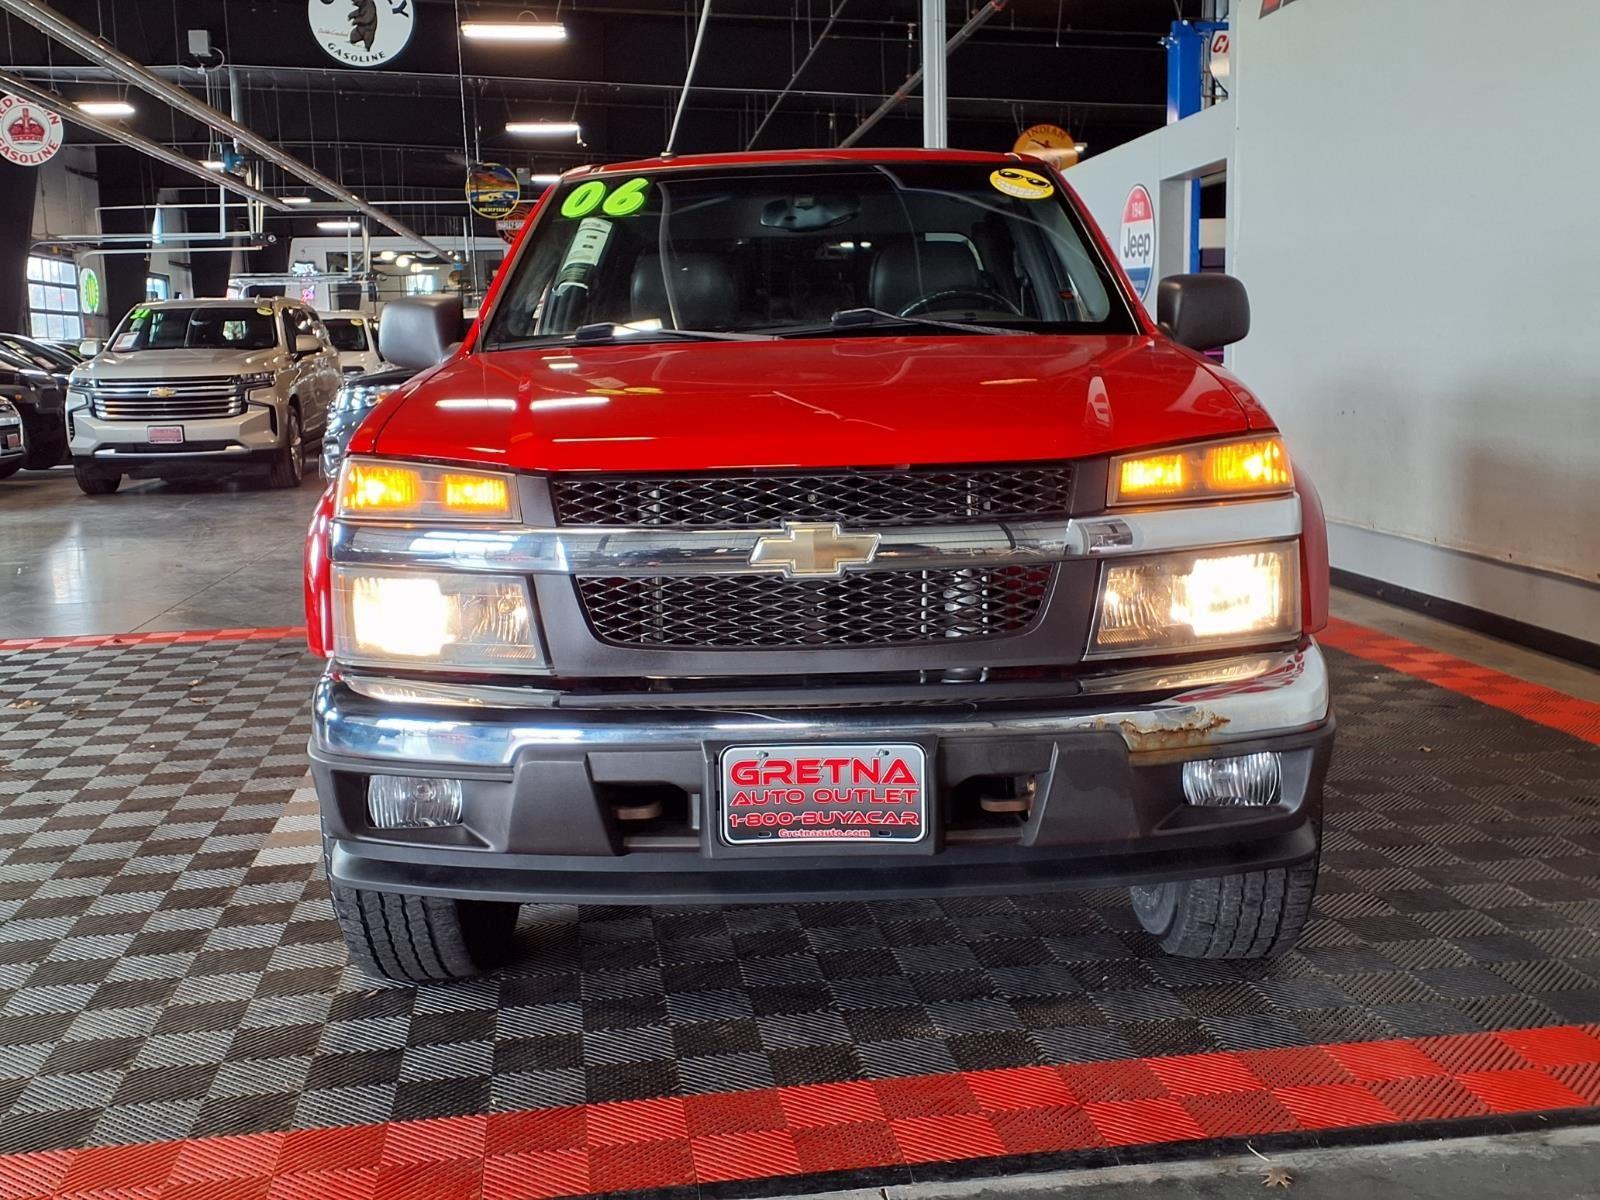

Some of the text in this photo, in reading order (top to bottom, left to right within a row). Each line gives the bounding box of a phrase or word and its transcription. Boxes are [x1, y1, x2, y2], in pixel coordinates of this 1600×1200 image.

[327, 42, 386, 63] GASOLINE
[1026, 126, 1066, 140] INDIAN
[561, 177, 649, 218] 06
[1131, 201, 1145, 218] 1941
[1123, 227, 1151, 265] Jeep
[730, 757, 918, 787] GRETNA
[729, 788, 920, 807] AUTO OUTLET
[729, 811, 920, 828] 1-800-BUYACAR
[777, 828, 871, 838] Gretnaauto.com
